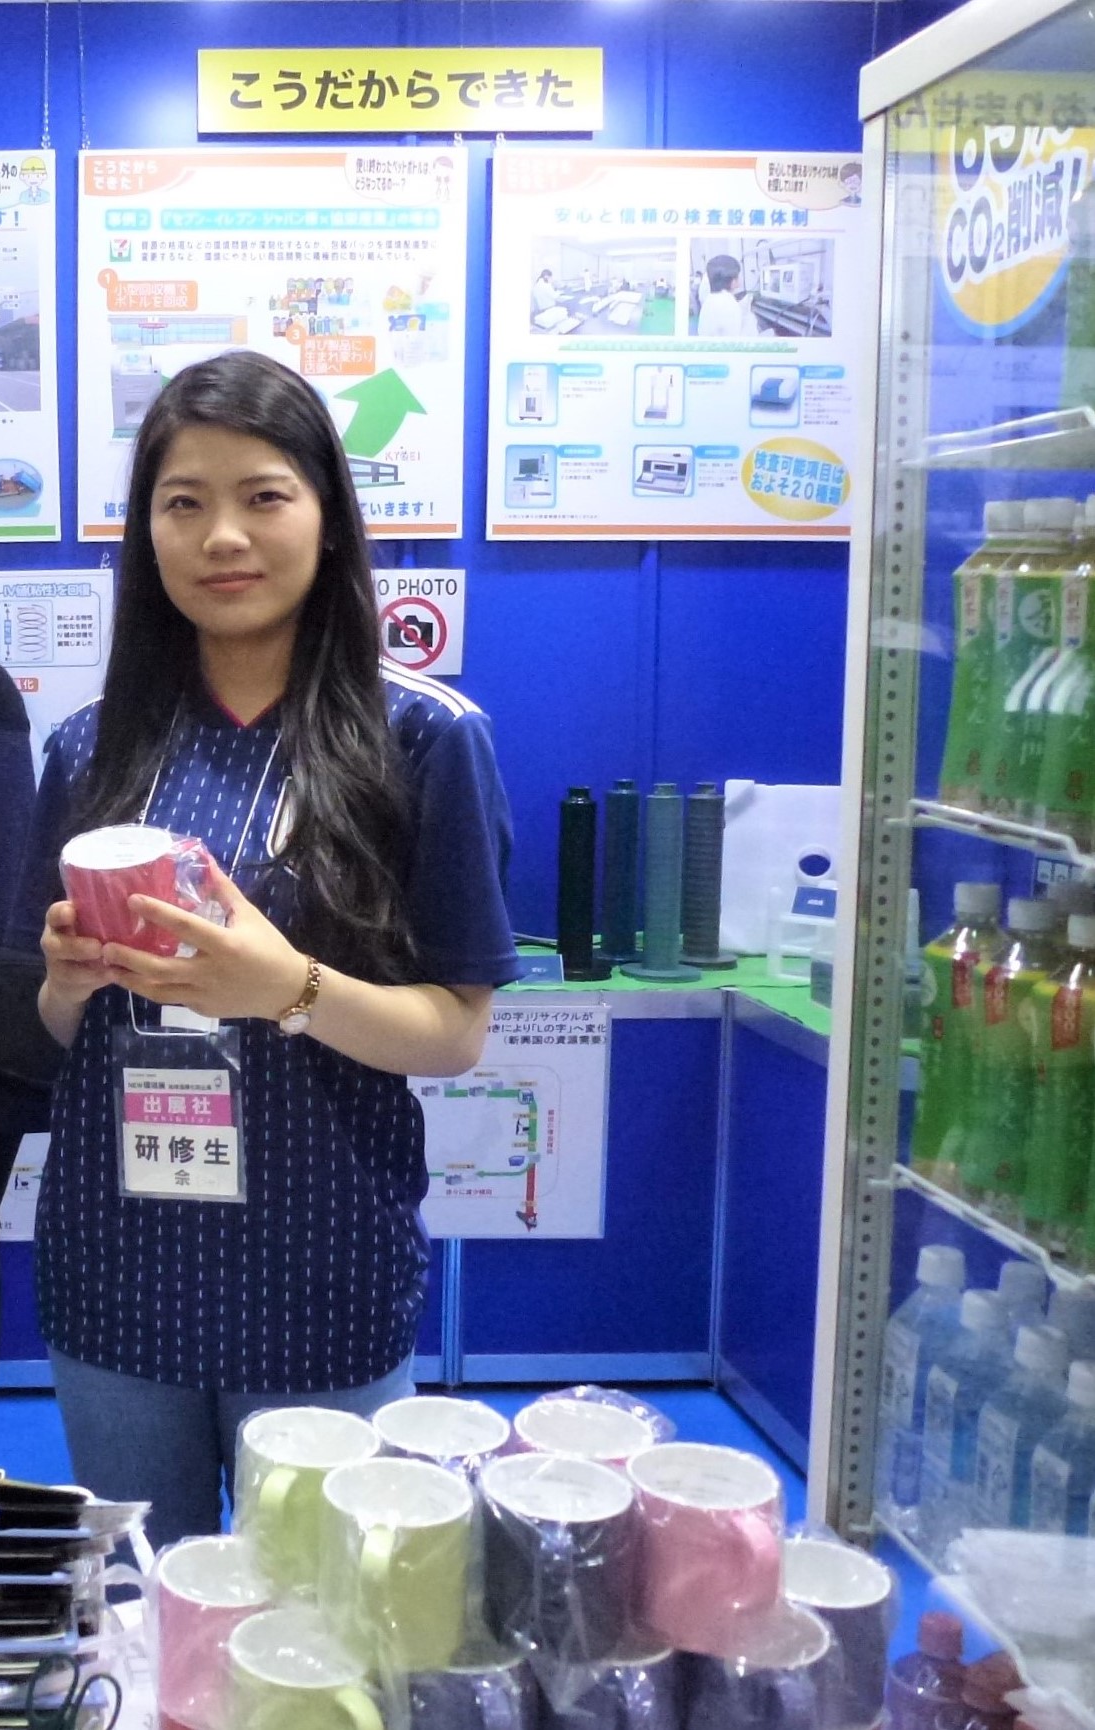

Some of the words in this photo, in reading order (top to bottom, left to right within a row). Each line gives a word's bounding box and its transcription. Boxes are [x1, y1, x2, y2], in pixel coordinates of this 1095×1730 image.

[229, 68, 575, 111] こうだからできた
[92, 159, 158, 175] こうだから
[554, 207, 810, 228] 安心と信頼の検査設備体制
[397, 578, 458, 596] PHOTO
[486, 1023, 608, 1034] きにより「Lの字」へ変化
[143, 1094, 212, 1115] 出展社
[134, 1134, 231, 1166] 研修生
